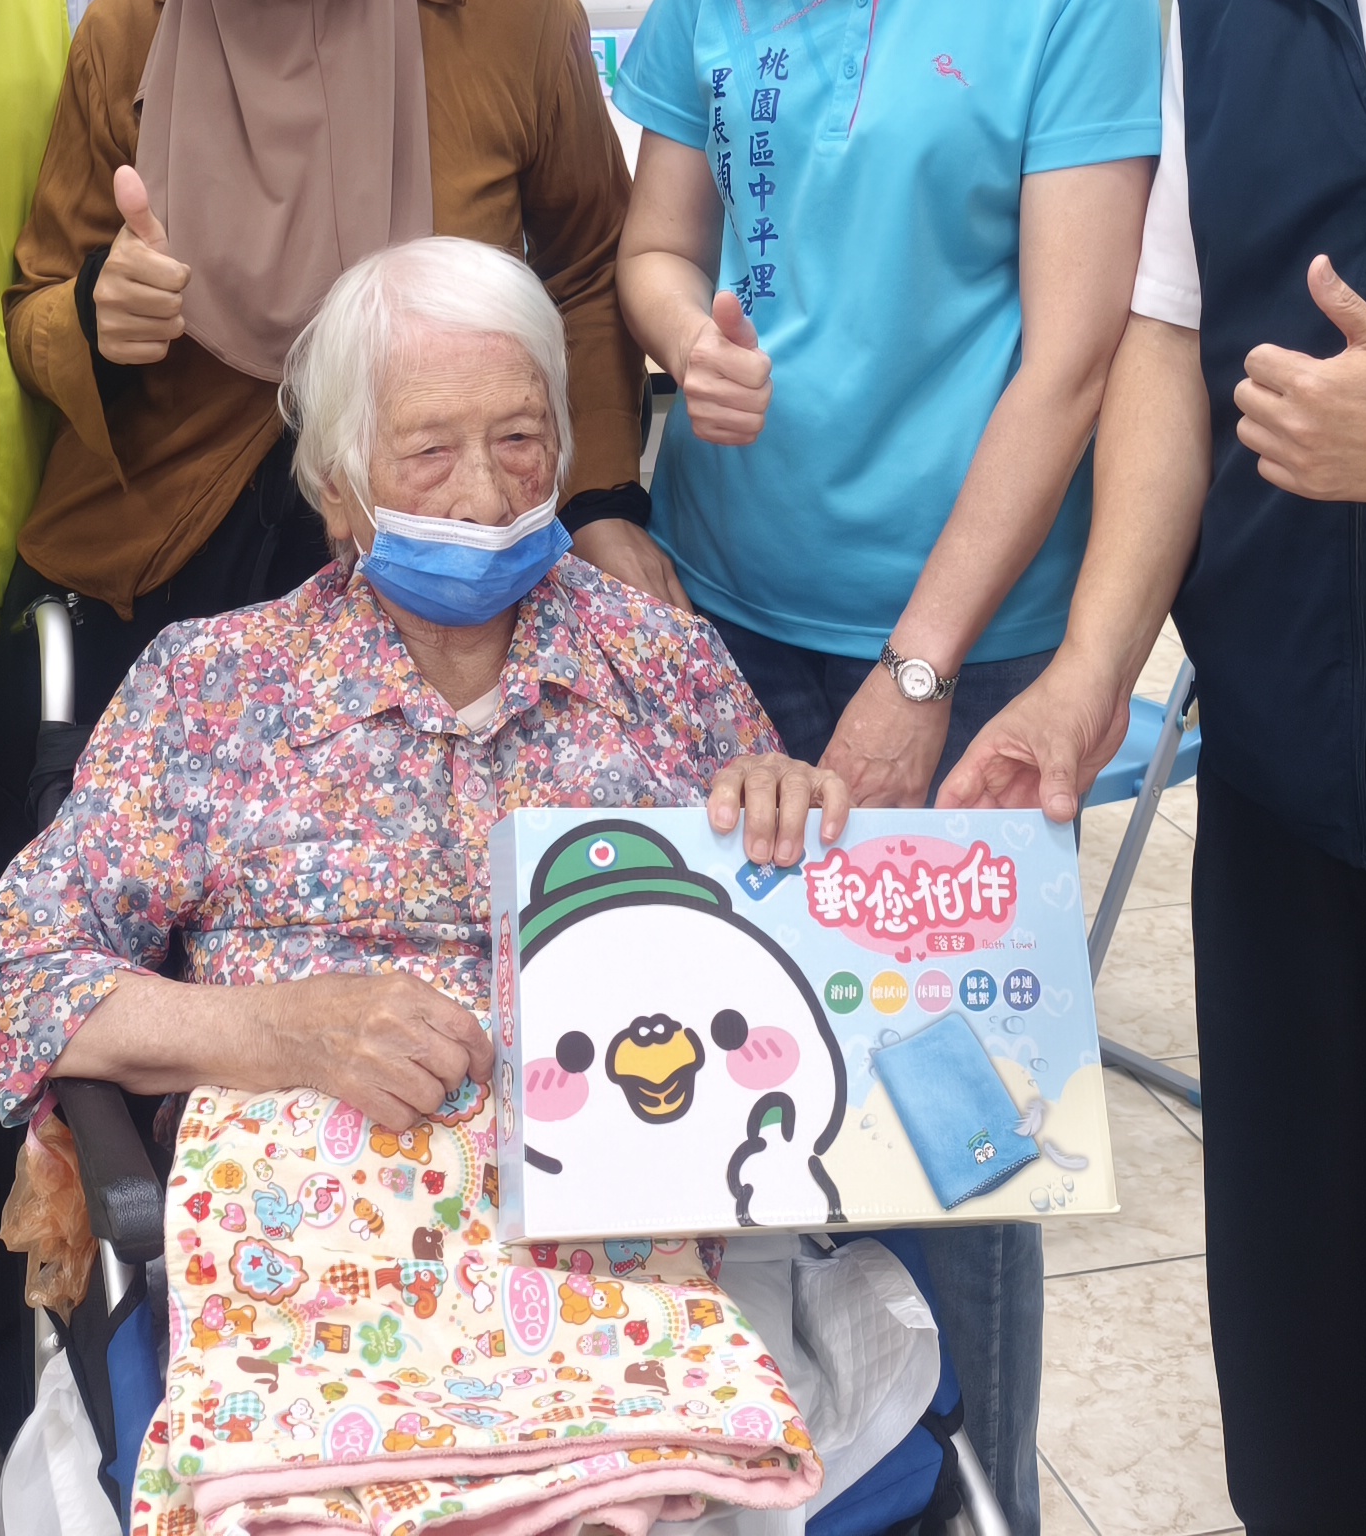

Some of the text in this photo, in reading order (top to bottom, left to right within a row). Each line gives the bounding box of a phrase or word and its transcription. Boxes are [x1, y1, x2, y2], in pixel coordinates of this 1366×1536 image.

[747, 47, 789, 299] 桃園區中平里
[809, 847, 1011, 934] 郵您相伴
[830, 983, 857, 1001] 浴巾
[512, 1269, 546, 1341] vega
